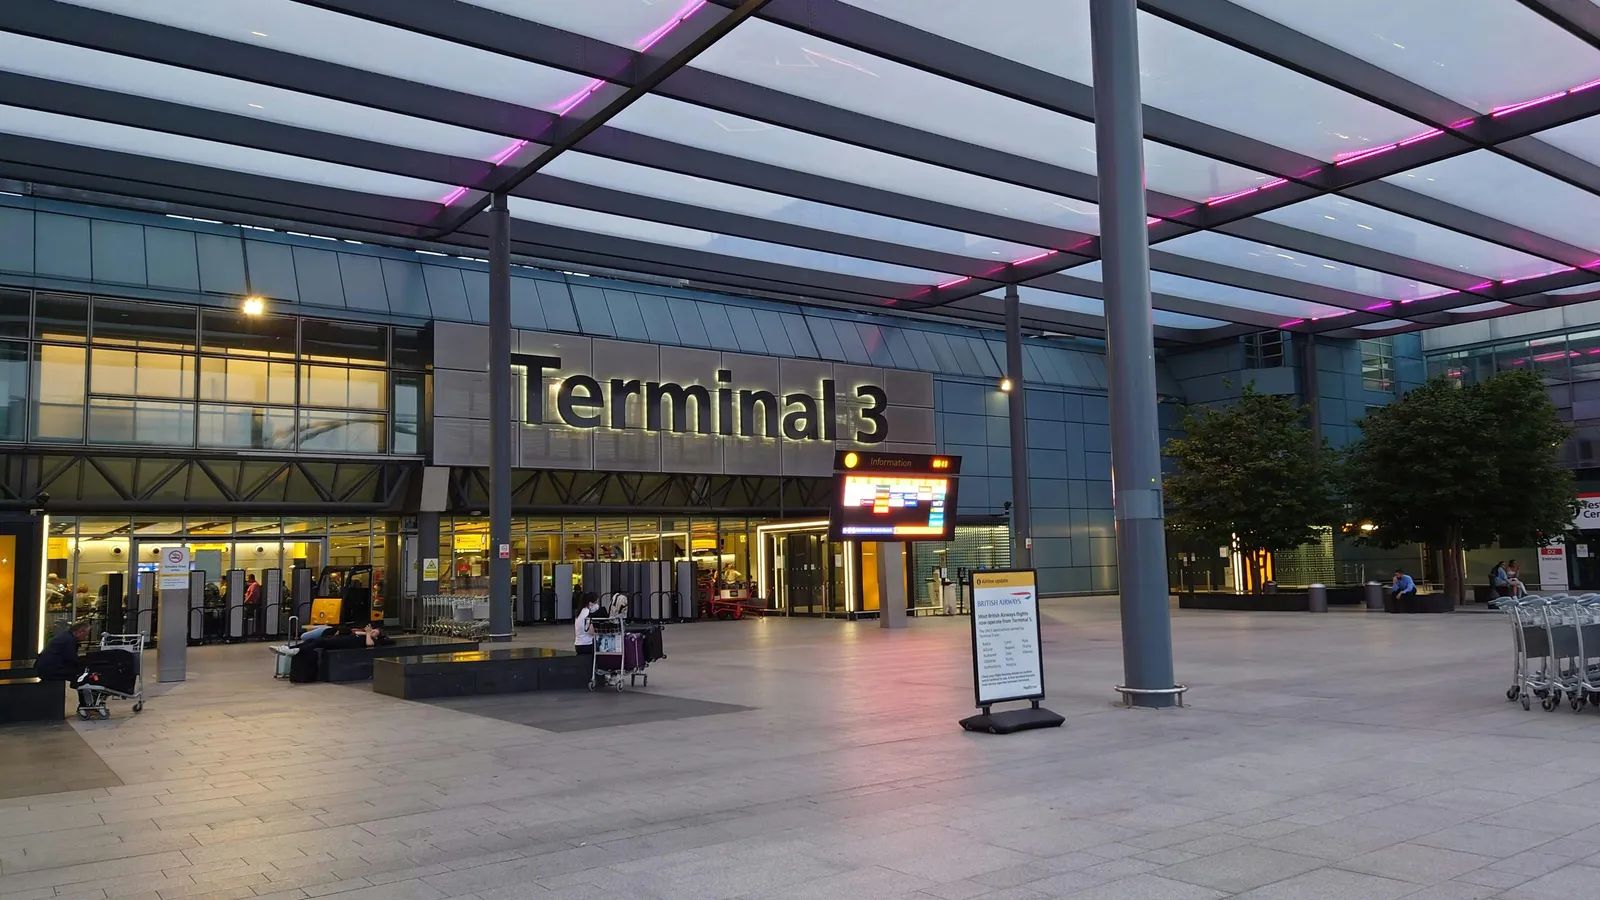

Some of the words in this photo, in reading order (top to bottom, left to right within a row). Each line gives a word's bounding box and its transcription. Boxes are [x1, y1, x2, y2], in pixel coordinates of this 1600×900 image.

[510, 353, 836, 441] Terminal
[856, 385, 888, 443] 3
[870, 457, 912, 467] Information
